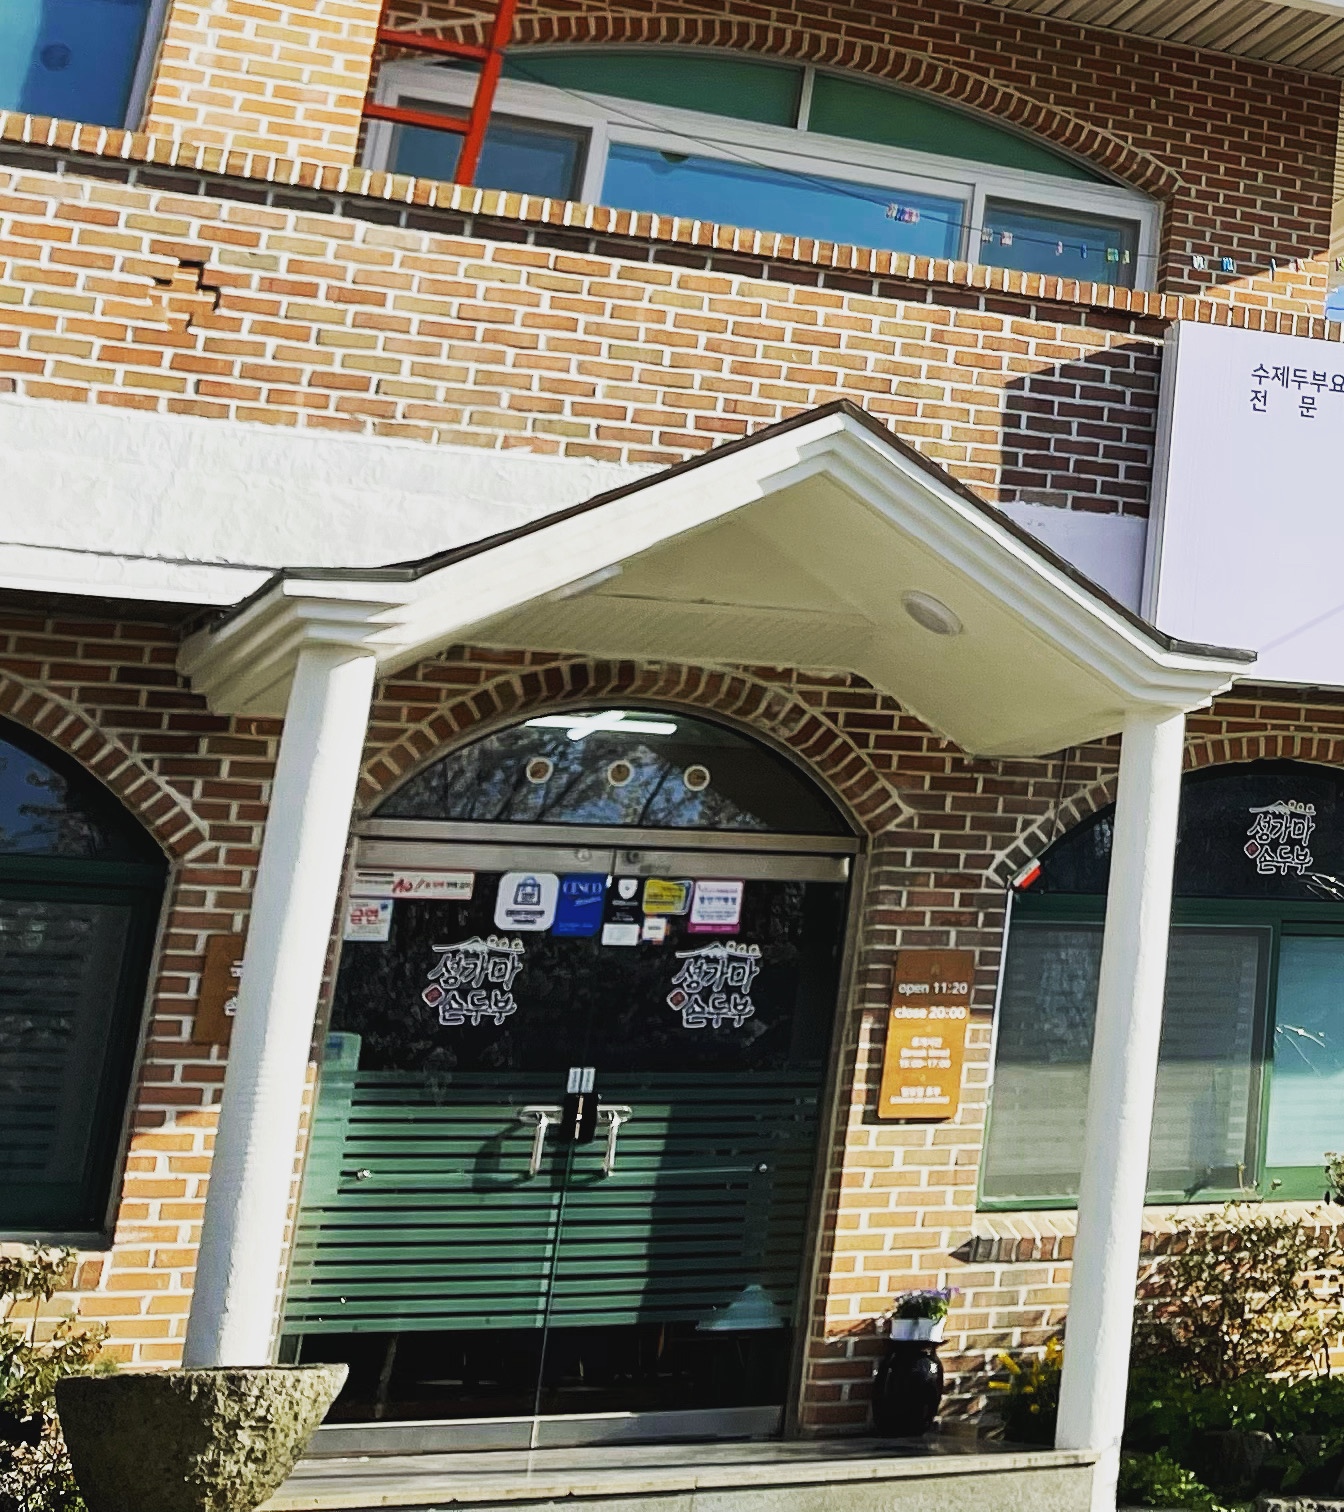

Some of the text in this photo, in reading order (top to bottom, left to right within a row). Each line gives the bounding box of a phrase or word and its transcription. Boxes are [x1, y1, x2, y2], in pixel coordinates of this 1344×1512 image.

[1256, 845, 1314, 875] 손두부
[898, 981, 968, 996] open 11:20
[438, 989, 518, 1026] 손두부
[682, 993, 755, 1029] 손두부
[894, 1005, 967, 1020] close 20:00
